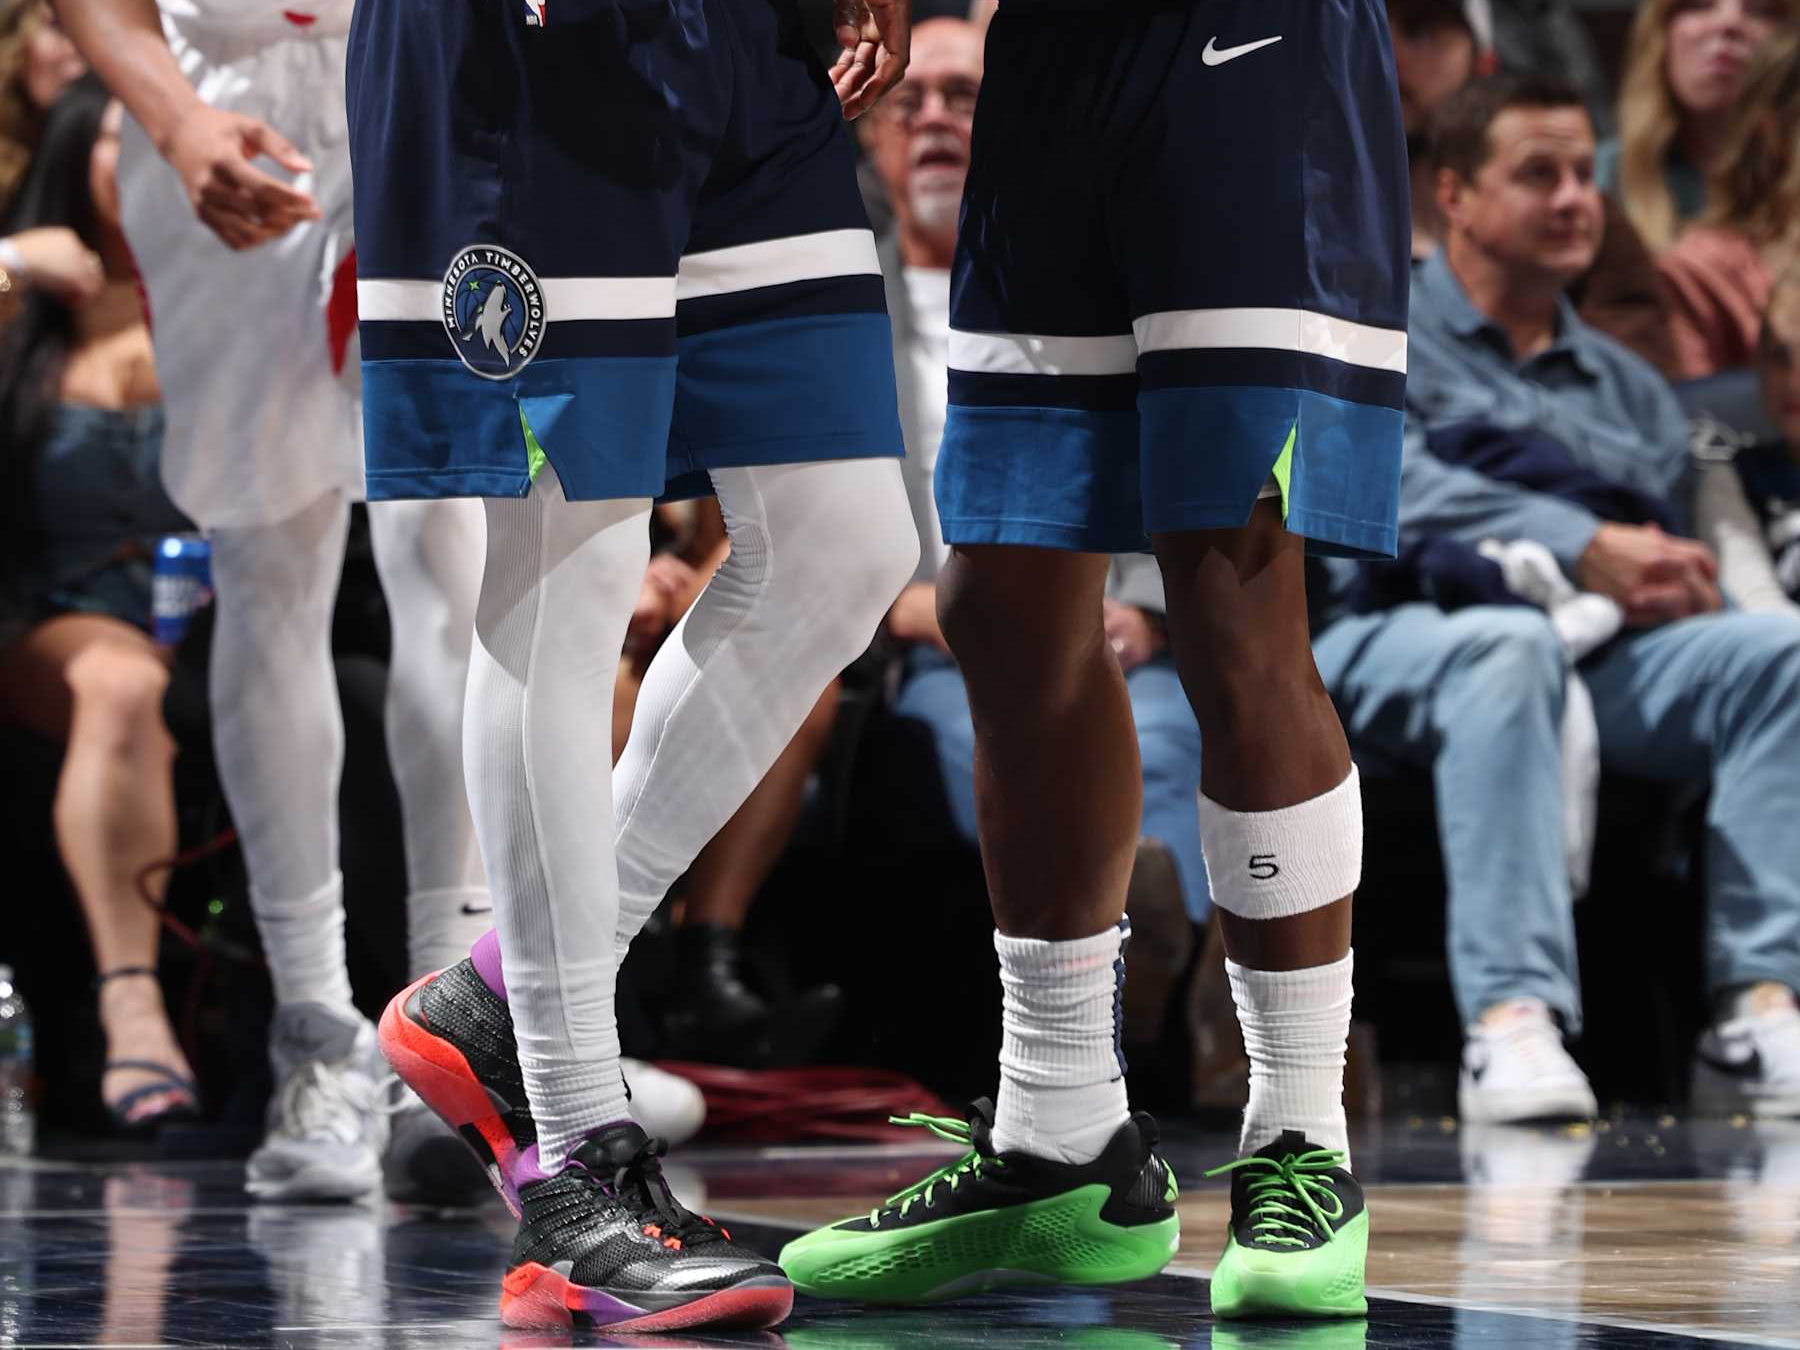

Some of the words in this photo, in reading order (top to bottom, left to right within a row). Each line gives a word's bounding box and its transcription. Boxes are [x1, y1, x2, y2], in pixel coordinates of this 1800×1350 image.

[443, 252, 479, 329] MINNESOTA
[485, 251, 541, 358] TIMBERWOLVES
[1249, 854, 1279, 880] 5
